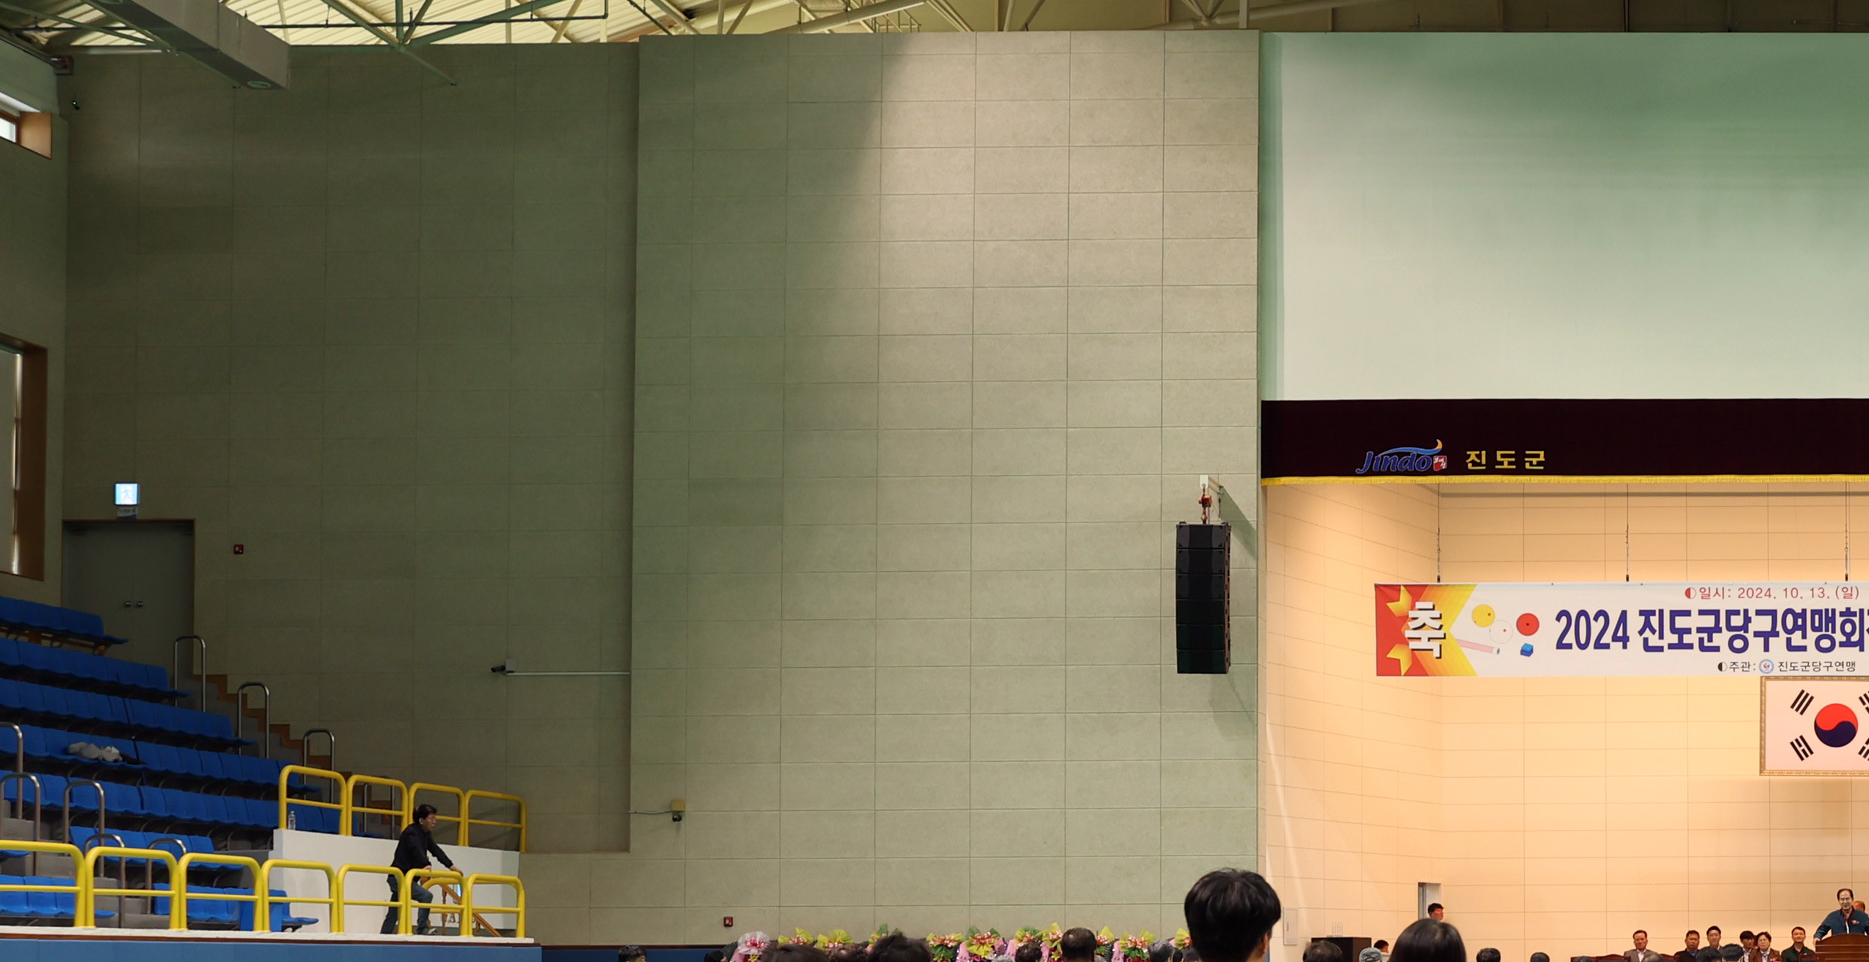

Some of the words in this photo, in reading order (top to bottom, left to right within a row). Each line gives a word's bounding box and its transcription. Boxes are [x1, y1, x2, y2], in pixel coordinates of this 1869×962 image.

[1355, 451, 1432, 474] Jindo
[1465, 450, 1546, 470] 진도군
[1699, 587, 1731, 600] 일시:
[1738, 587, 1777, 600] 2024.
[1835, 586, 1860, 600] (일)
[1404, 601, 1446, 659] 축
[1555, 609, 1630, 650] 2024
[1729, 661, 1756, 672] 주관:
[1778, 661, 1856, 673] 진도군당구연맹
